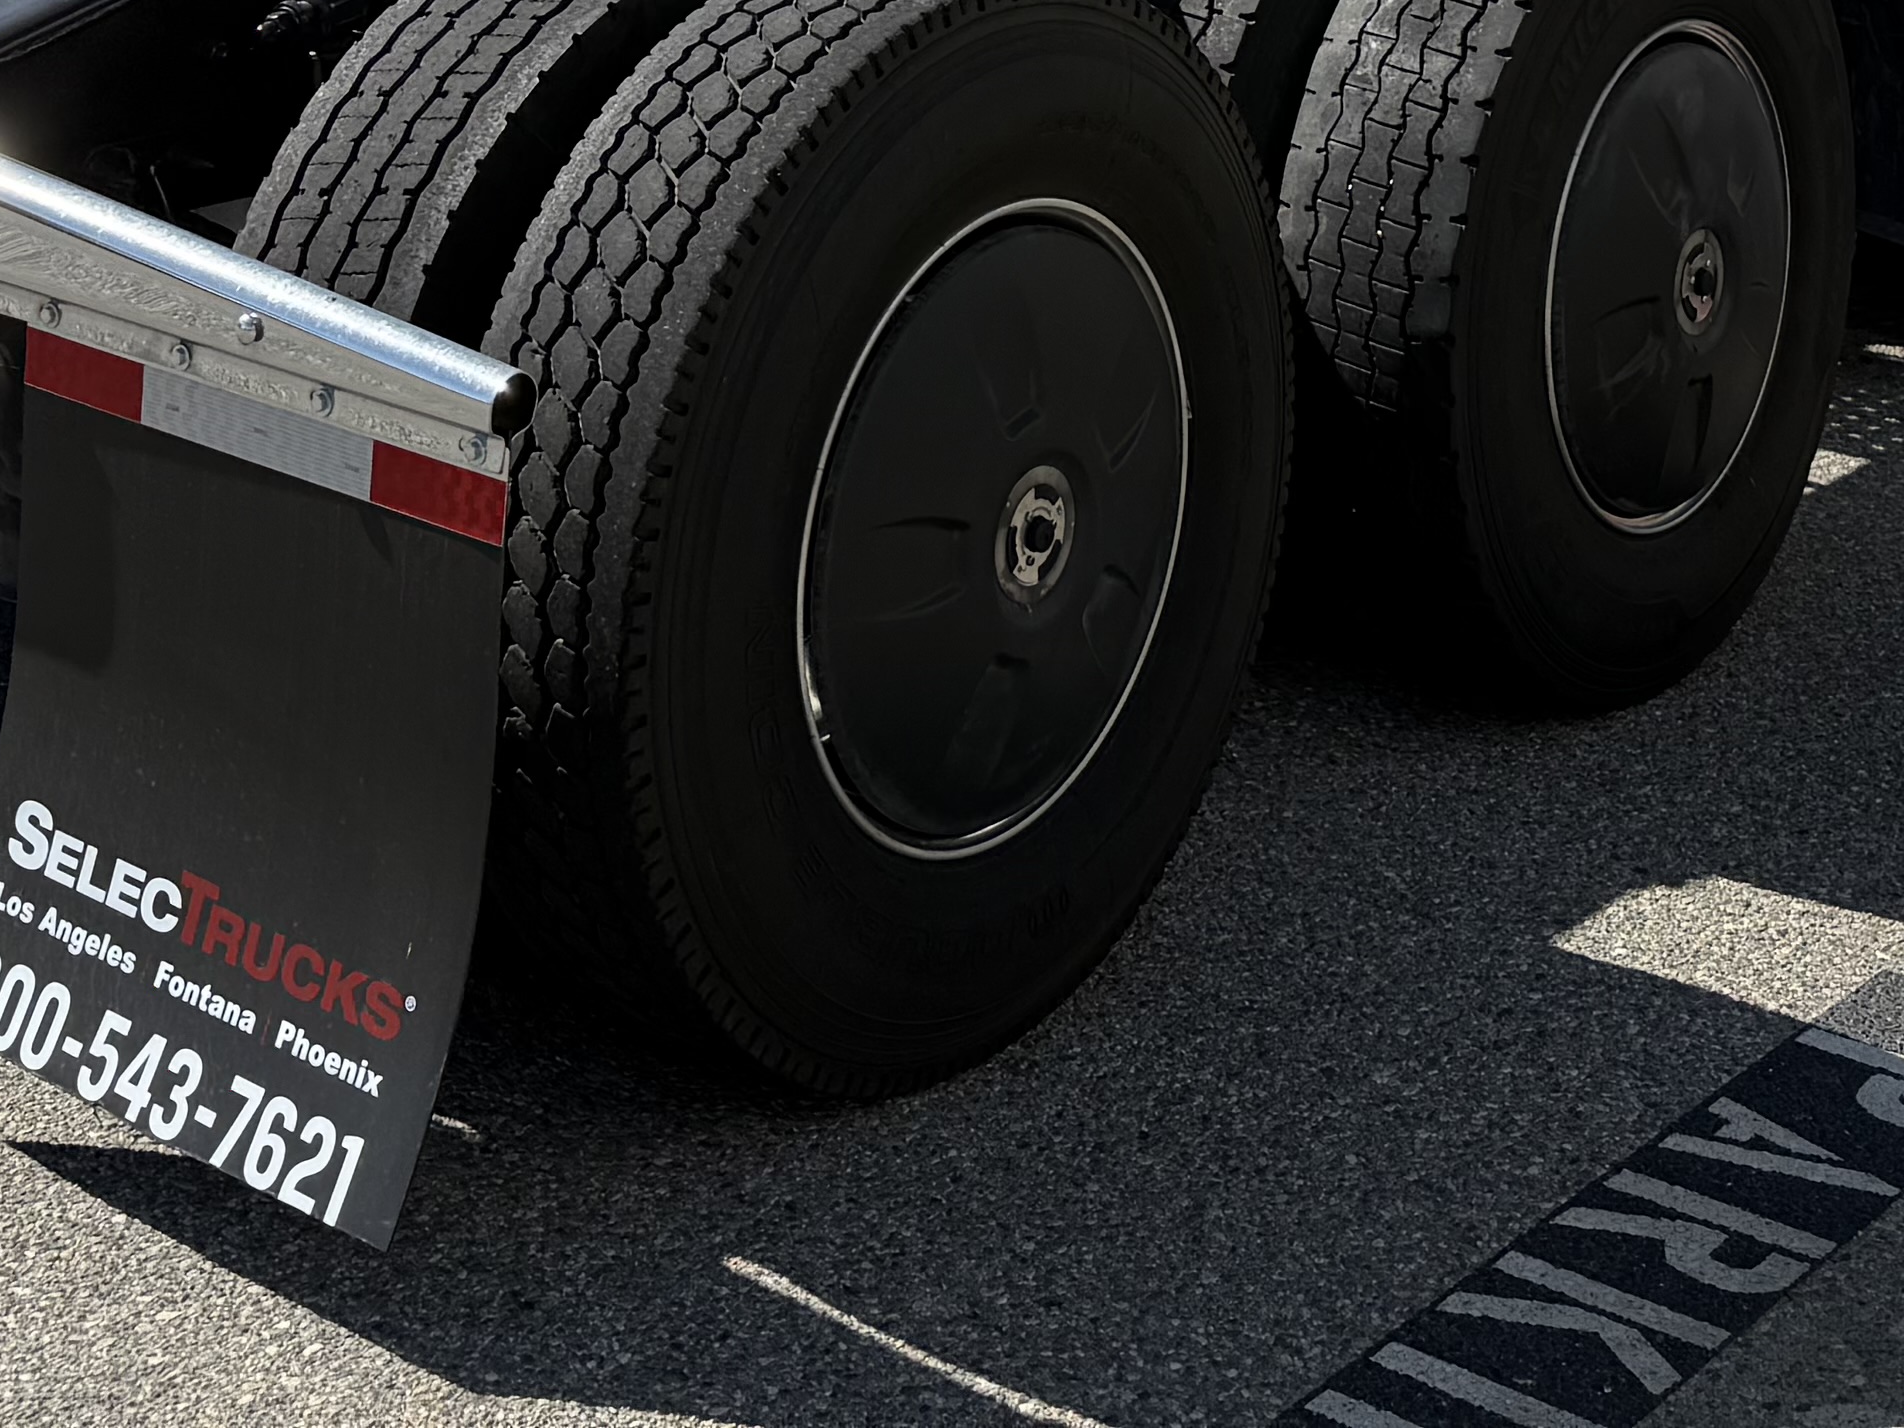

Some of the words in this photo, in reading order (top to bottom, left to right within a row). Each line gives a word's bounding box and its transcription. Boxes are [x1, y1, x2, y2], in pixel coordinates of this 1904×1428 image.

[38, 907, 137, 974] Angeles
[153, 960, 257, 1035] Fontana
[274, 1020, 385, 1098] Phoenix
